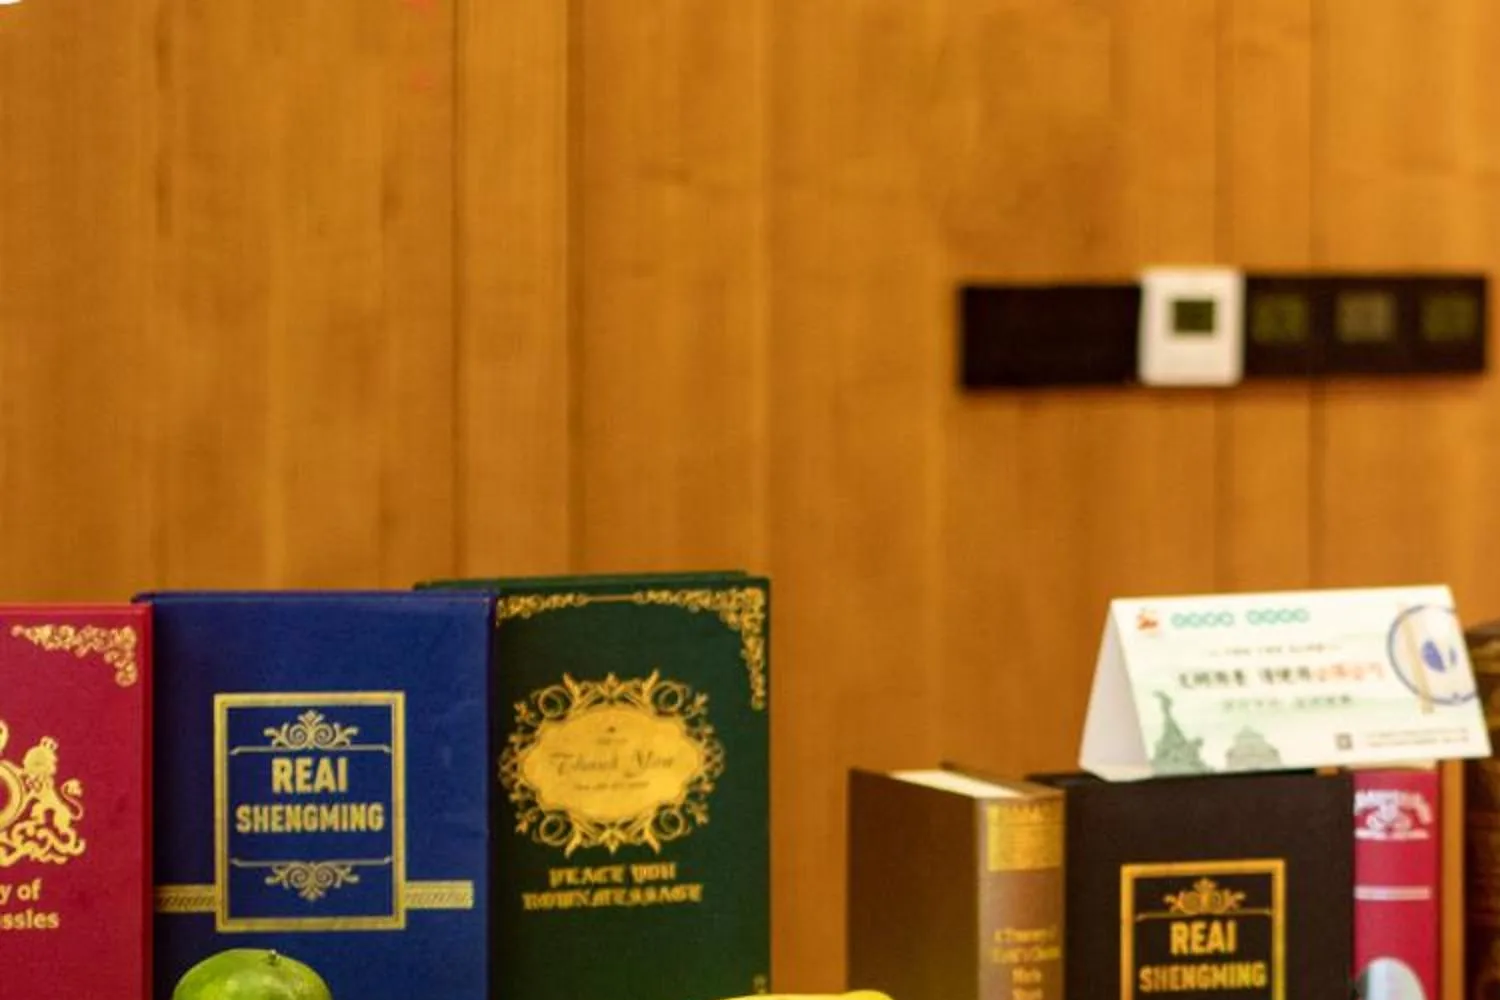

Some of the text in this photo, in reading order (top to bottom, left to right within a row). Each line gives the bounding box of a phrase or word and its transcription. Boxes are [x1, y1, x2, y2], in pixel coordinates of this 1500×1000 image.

[235, 803, 385, 834] SHENGMING
[17, 877, 42, 901] of
[1138, 960, 1267, 993] SHENGMING
